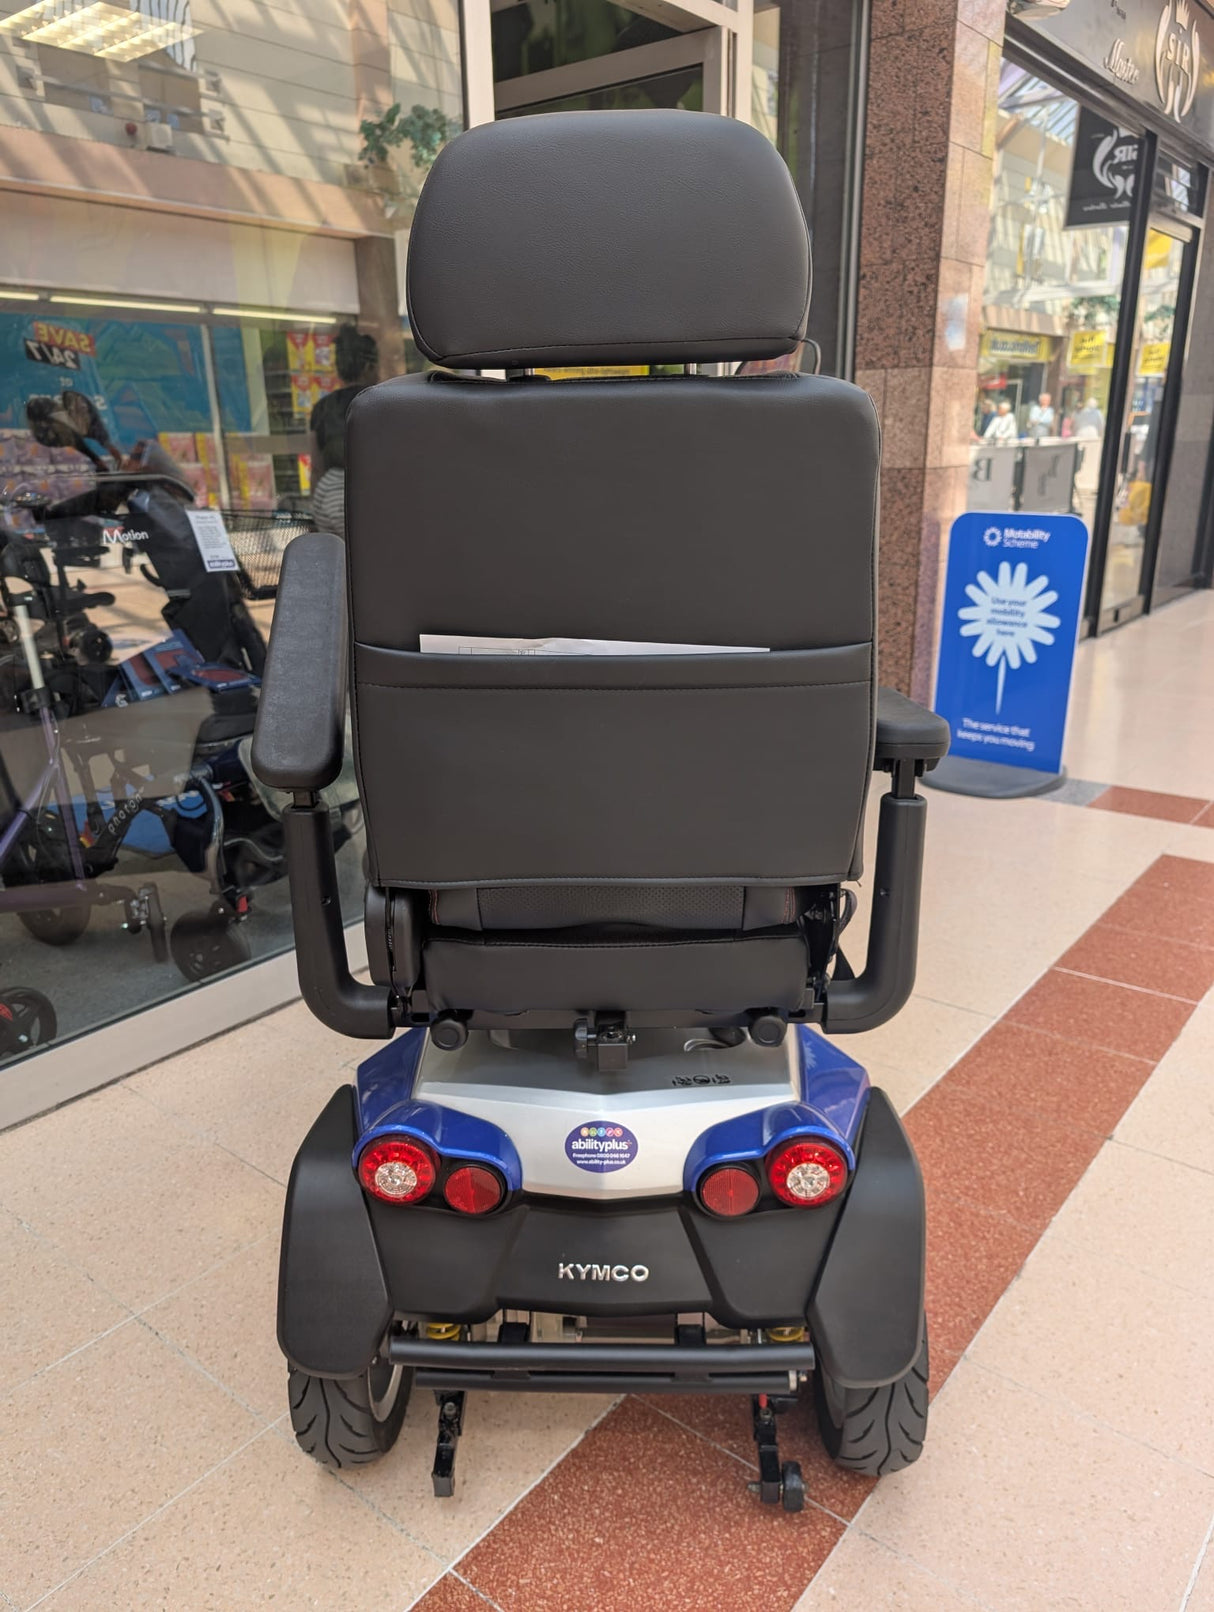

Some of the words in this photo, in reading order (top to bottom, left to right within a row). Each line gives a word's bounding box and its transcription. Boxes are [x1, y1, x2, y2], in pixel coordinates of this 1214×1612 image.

[103, 529, 149, 544] Motion
[1003, 527, 1050, 543] Motability
[1003, 538, 1038, 549] Scheme
[990, 608, 1025, 617] mobility
[987, 618, 1028, 627] allowance
[962, 717, 979, 729] The
[979, 720, 1010, 734] service
[1010, 725, 1031, 737] that
[956, 728, 983, 743] keeps
[983, 734, 1000, 745] you
[1000, 736, 1036, 752] moving
[571, 1138, 629, 1152] abilityplus
[558, 1262, 650, 1282] KYMCO
